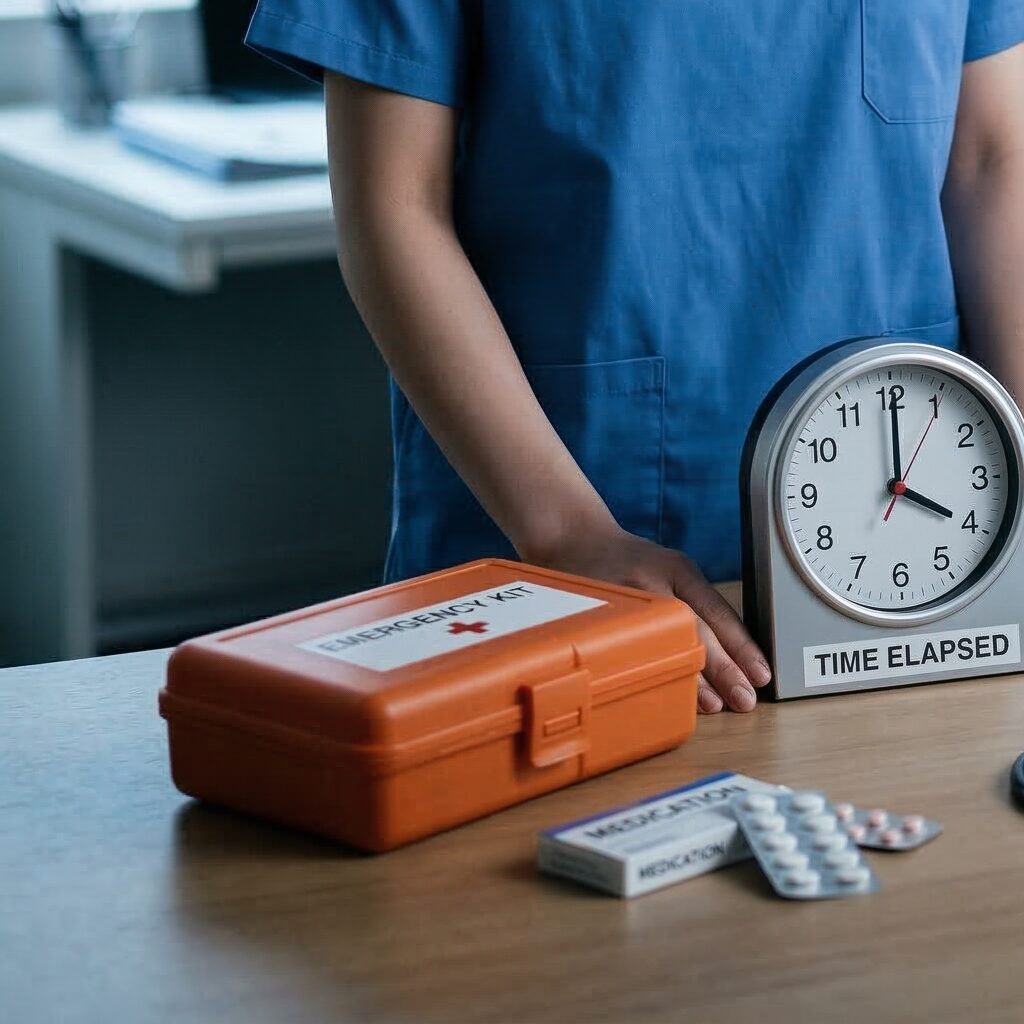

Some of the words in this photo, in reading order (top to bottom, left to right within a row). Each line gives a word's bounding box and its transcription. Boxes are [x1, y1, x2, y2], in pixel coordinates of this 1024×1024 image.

[876, 385, 905, 411] 12
[929, 395, 939, 419] 1
[836, 403, 861, 427] 11
[958, 423, 975, 448] 2
[808, 437, 837, 463] 10
[971, 466, 989, 490] 3
[800, 483, 818, 508] 9
[961, 510, 979, 534] 4
[816, 525, 834, 550] 8
[850, 555, 867, 579] 7
[933, 546, 950, 571] 5
[892, 563, 910, 587] 6
[318, 600, 487, 652] EMERGENCY
[487, 586, 534, 603] KIT
[815, 649, 879, 675] TIME
[888, 634, 1009, 667] ELAPSED
[583, 785, 747, 839] MEDICATION
[640, 841, 726, 879] MEDICATION
